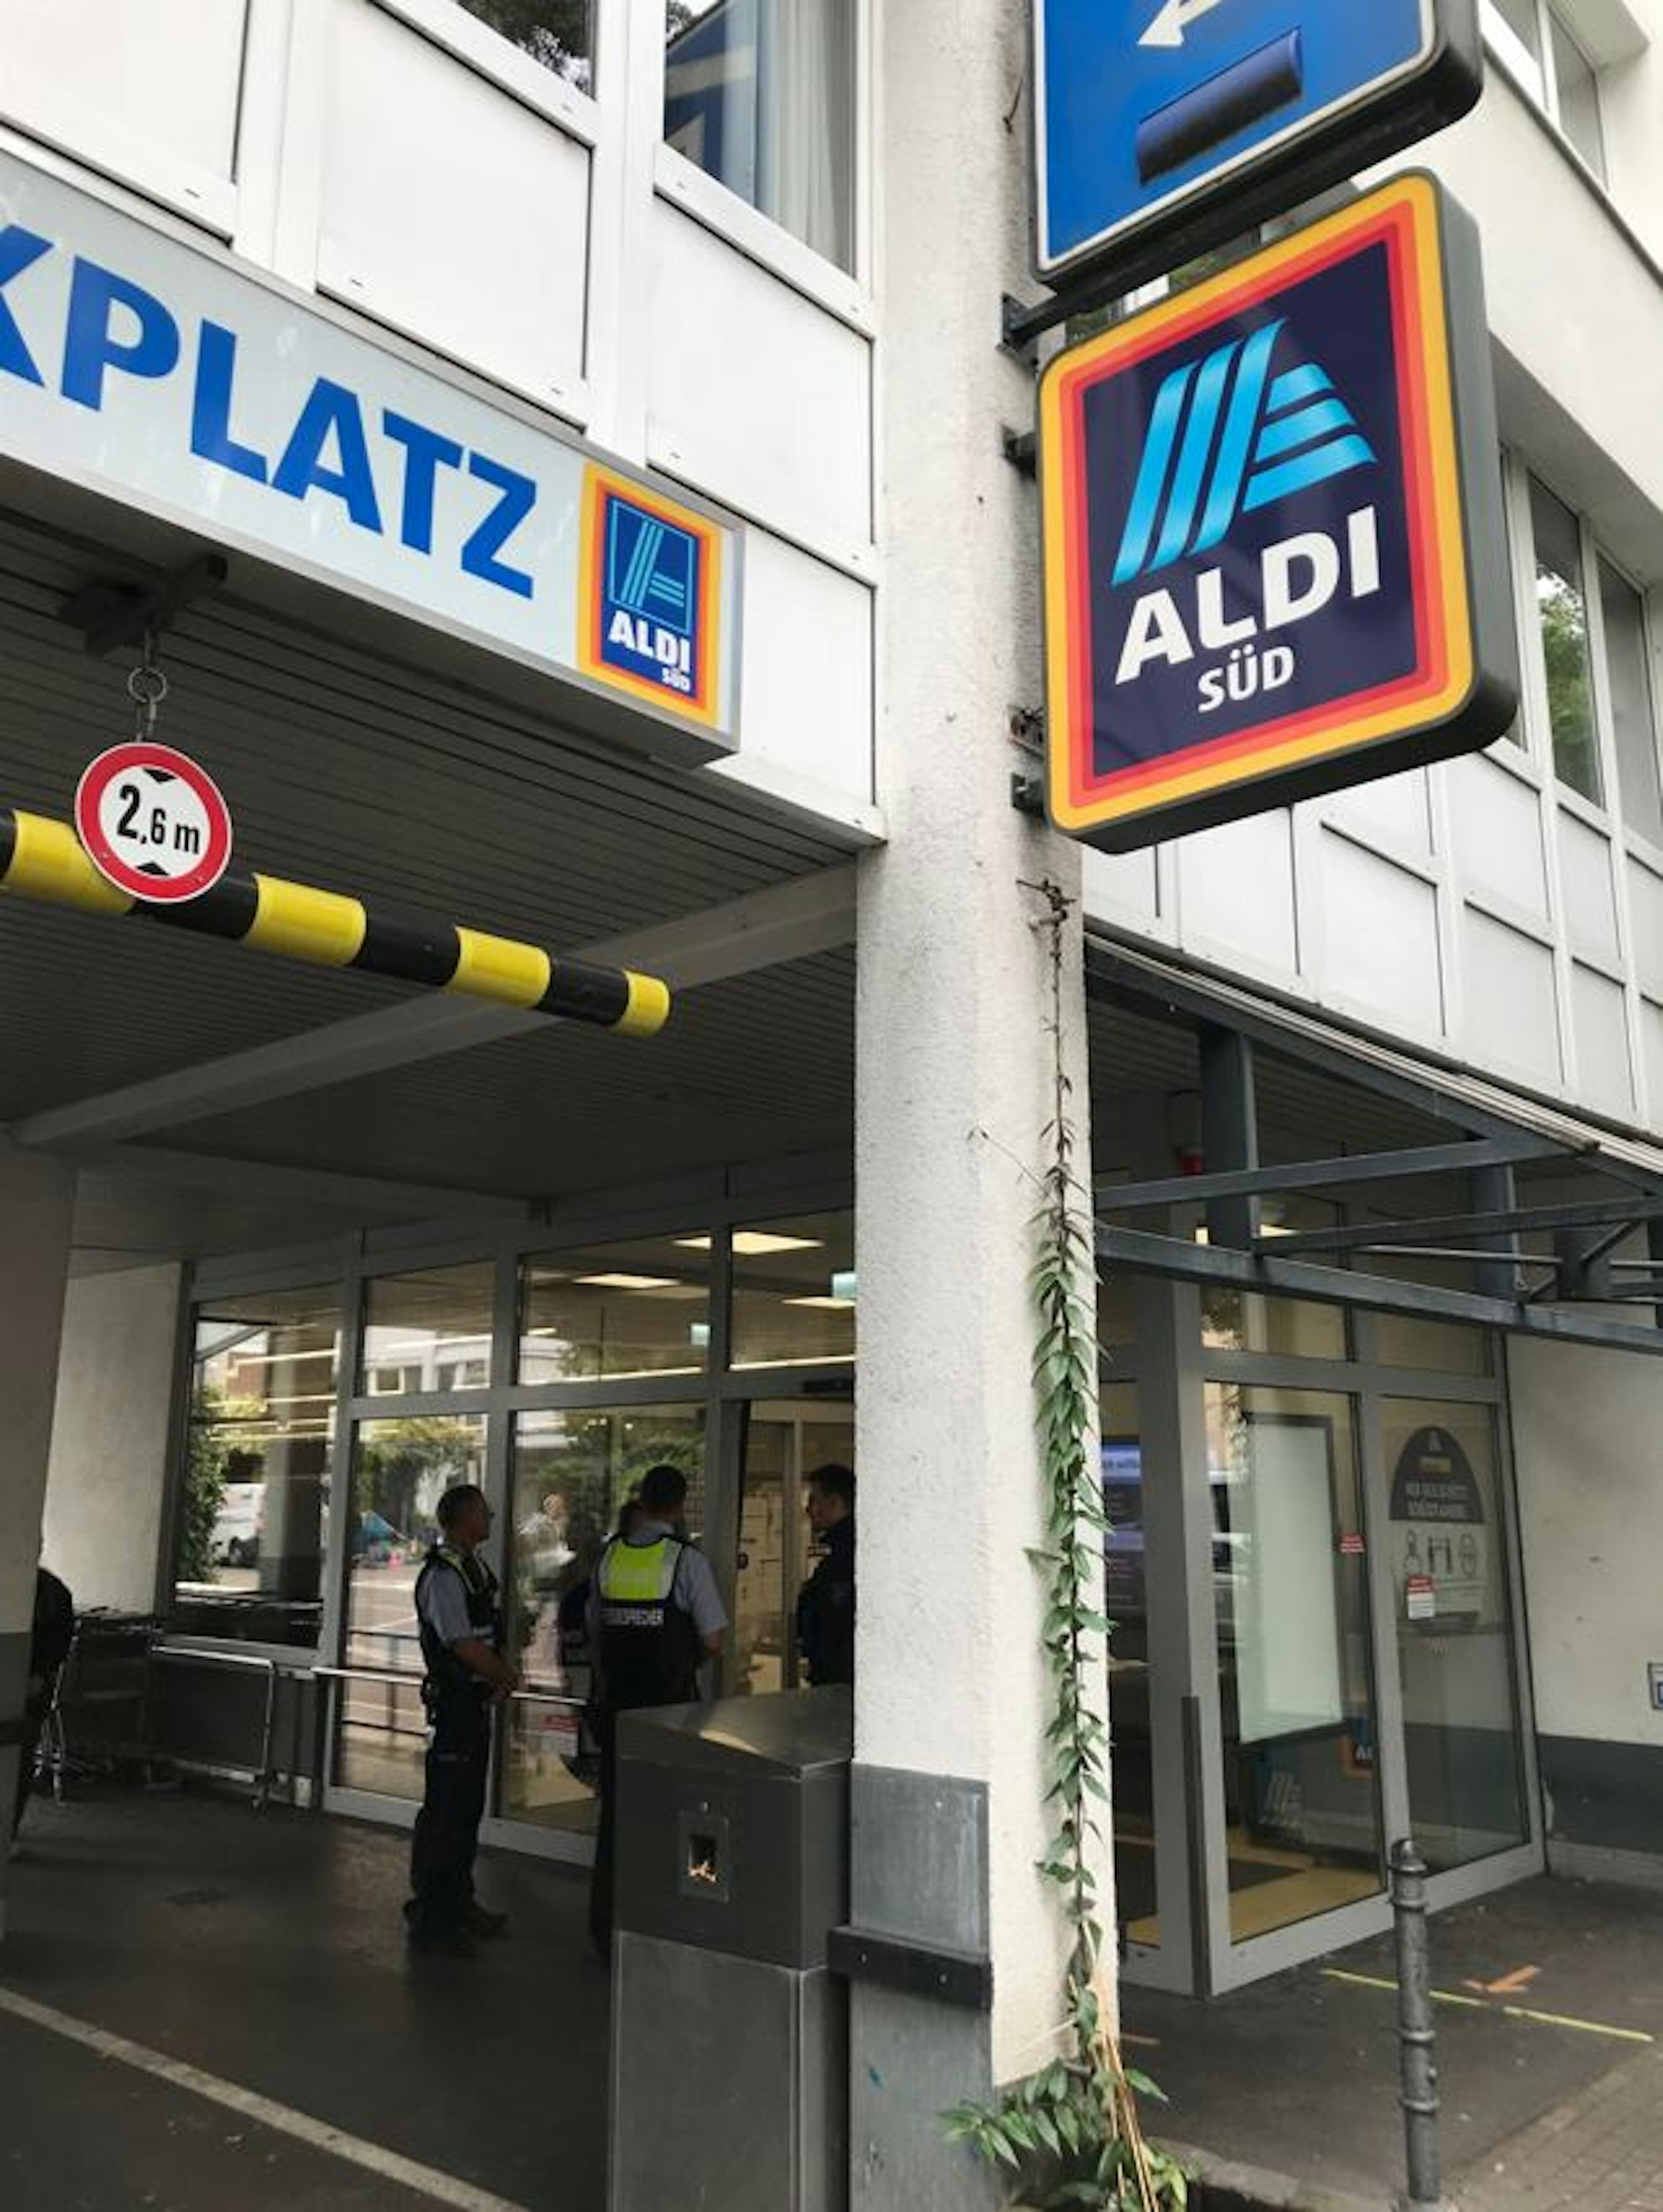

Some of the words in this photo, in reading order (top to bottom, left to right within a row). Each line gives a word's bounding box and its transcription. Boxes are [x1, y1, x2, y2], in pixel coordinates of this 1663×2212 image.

[1114, 503, 1380, 685] ALDI
[608, 610, 691, 672] ALDI
[1197, 643, 1295, 713] SÜD
[116, 784, 166, 845] 2,6
[173, 822, 200, 855] m
